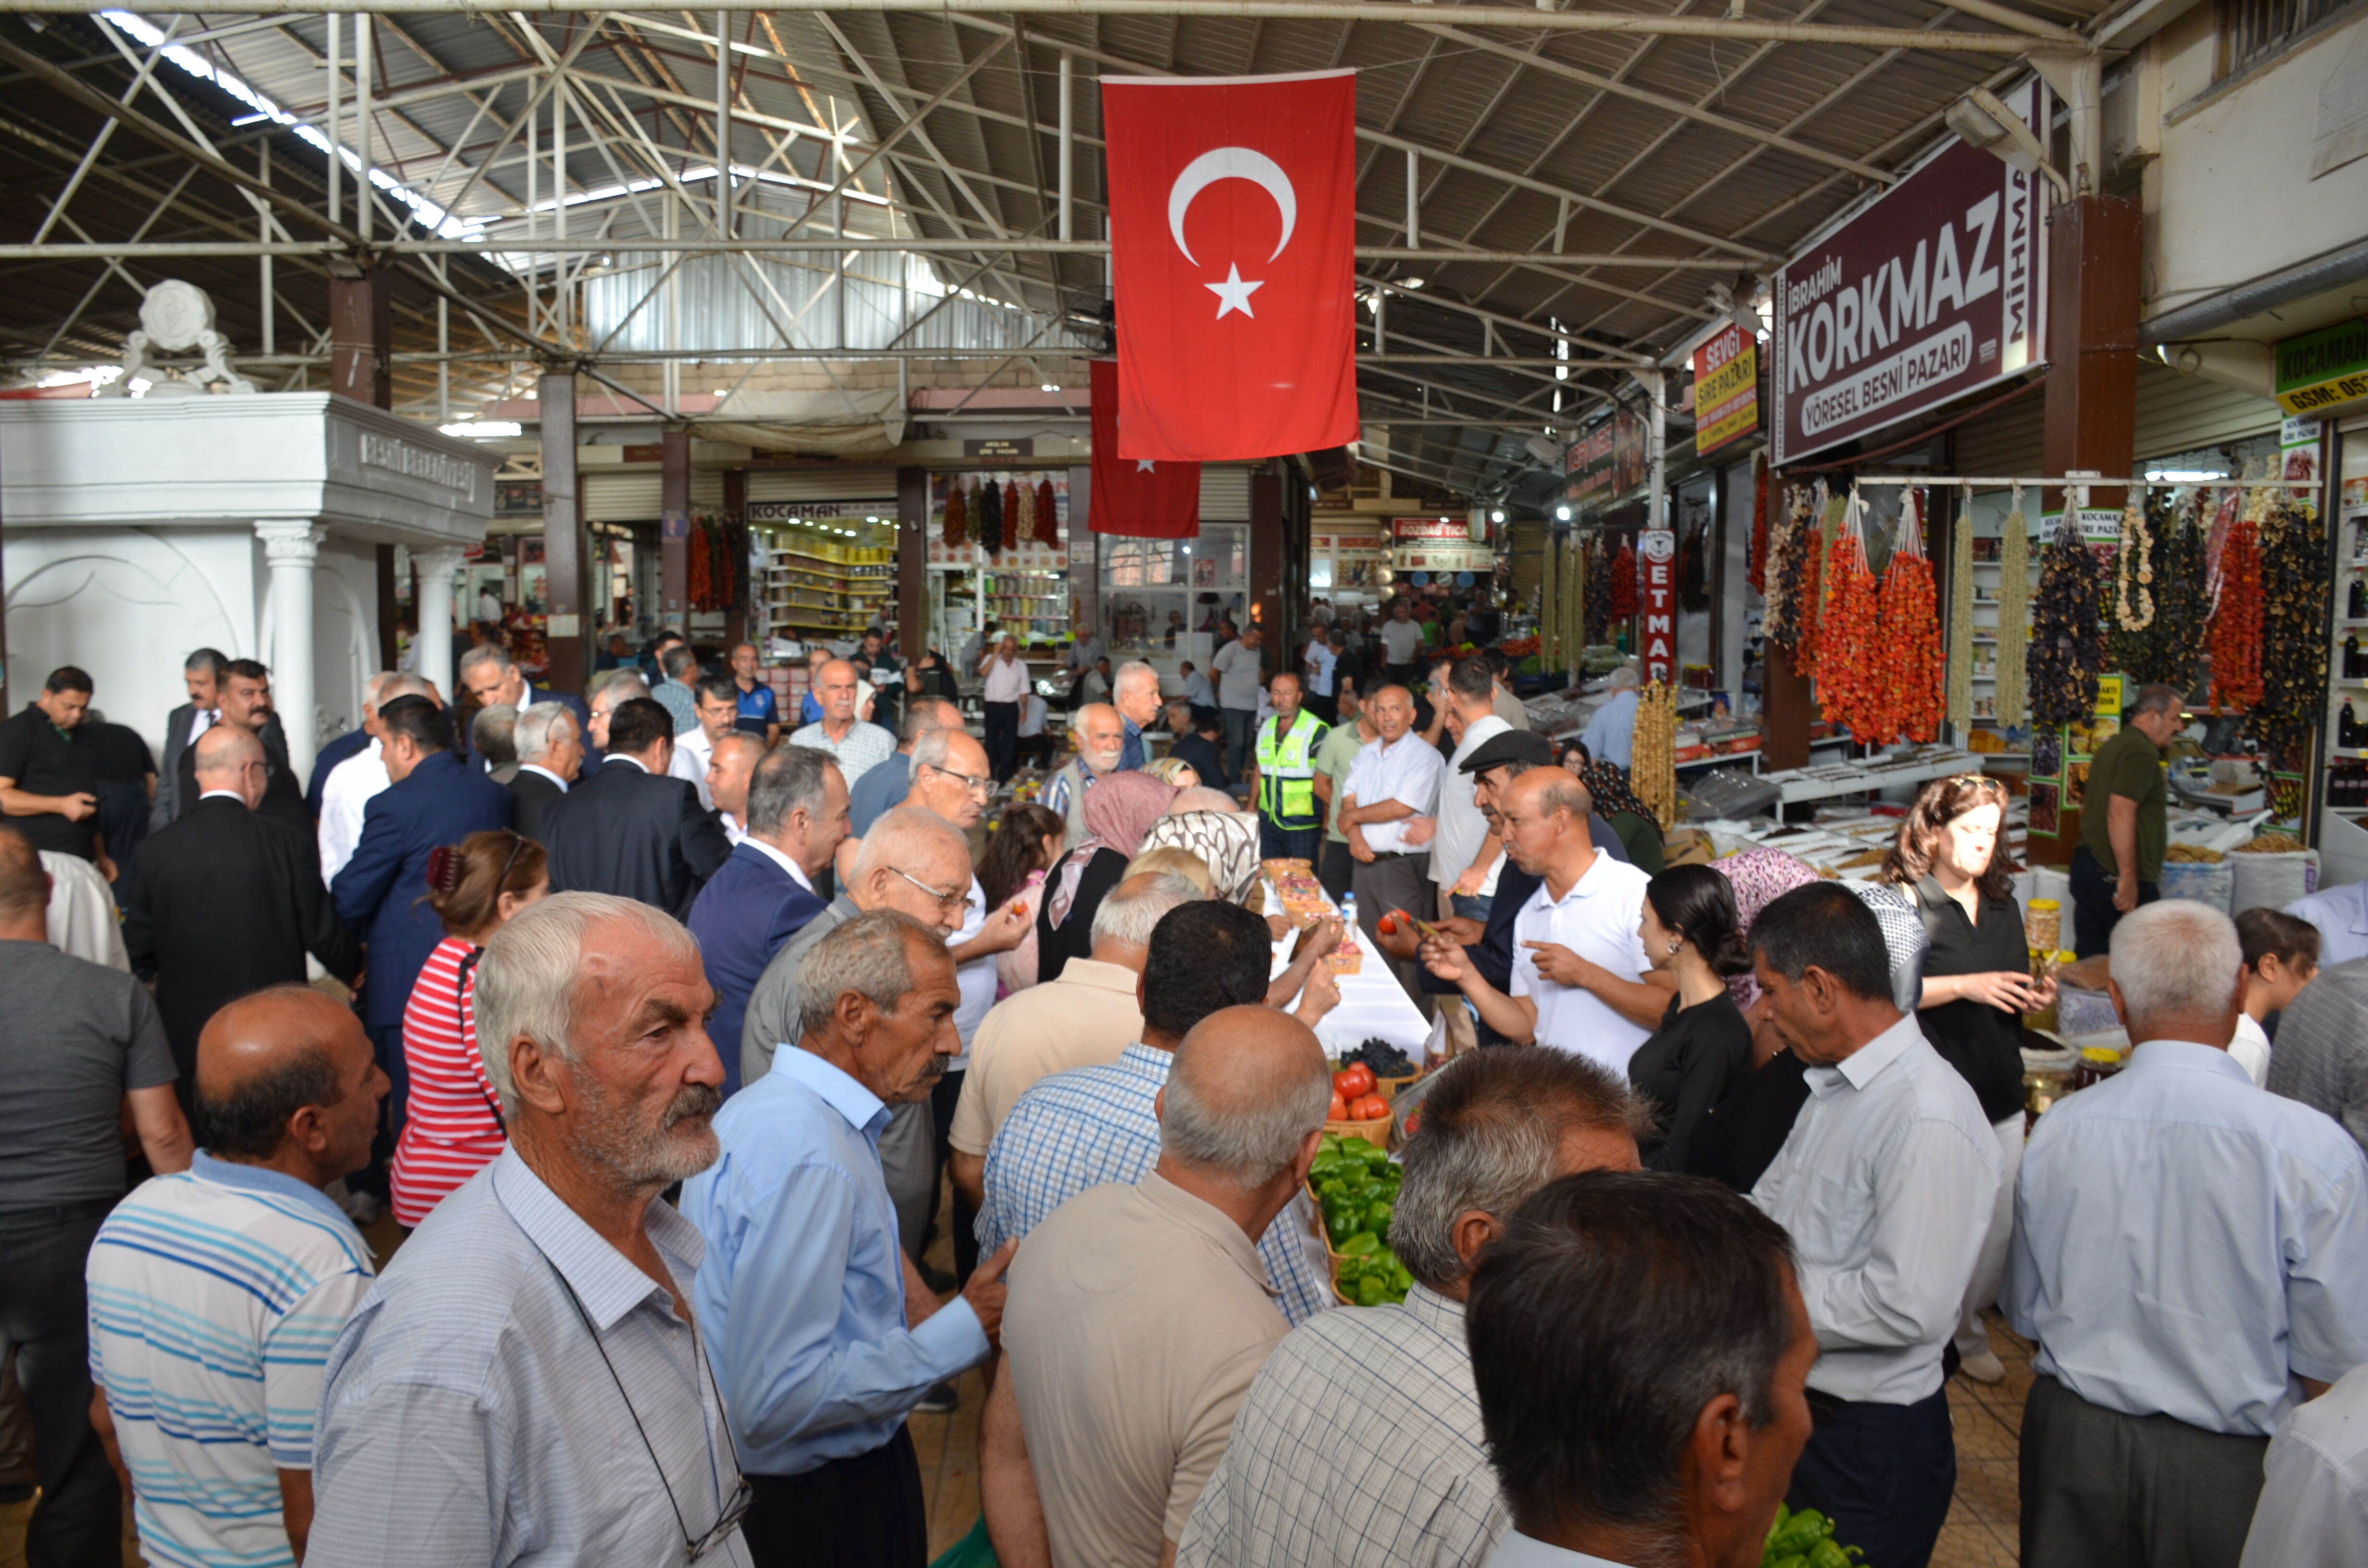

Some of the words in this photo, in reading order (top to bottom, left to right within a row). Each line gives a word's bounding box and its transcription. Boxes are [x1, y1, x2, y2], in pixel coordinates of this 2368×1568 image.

[2006, 167, 2027, 346] MİHMA
[1788, 255, 1841, 316] İBRAHİM
[1788, 191, 1999, 395] KORKMAZ
[1706, 325, 1740, 372] SEVGİ
[1719, 355, 1752, 395] PAZARI
[1806, 386, 1858, 430] YÖRESEL
[1862, 355, 1903, 408] BESNİ
[1908, 334, 1966, 388] PAZARI
[2289, 386, 2342, 410] GSM:
[752, 505, 840, 518] KOCAMAN
[2082, 513, 2119, 522] KOCAMA
[2097, 525, 2119, 534] PAZA
